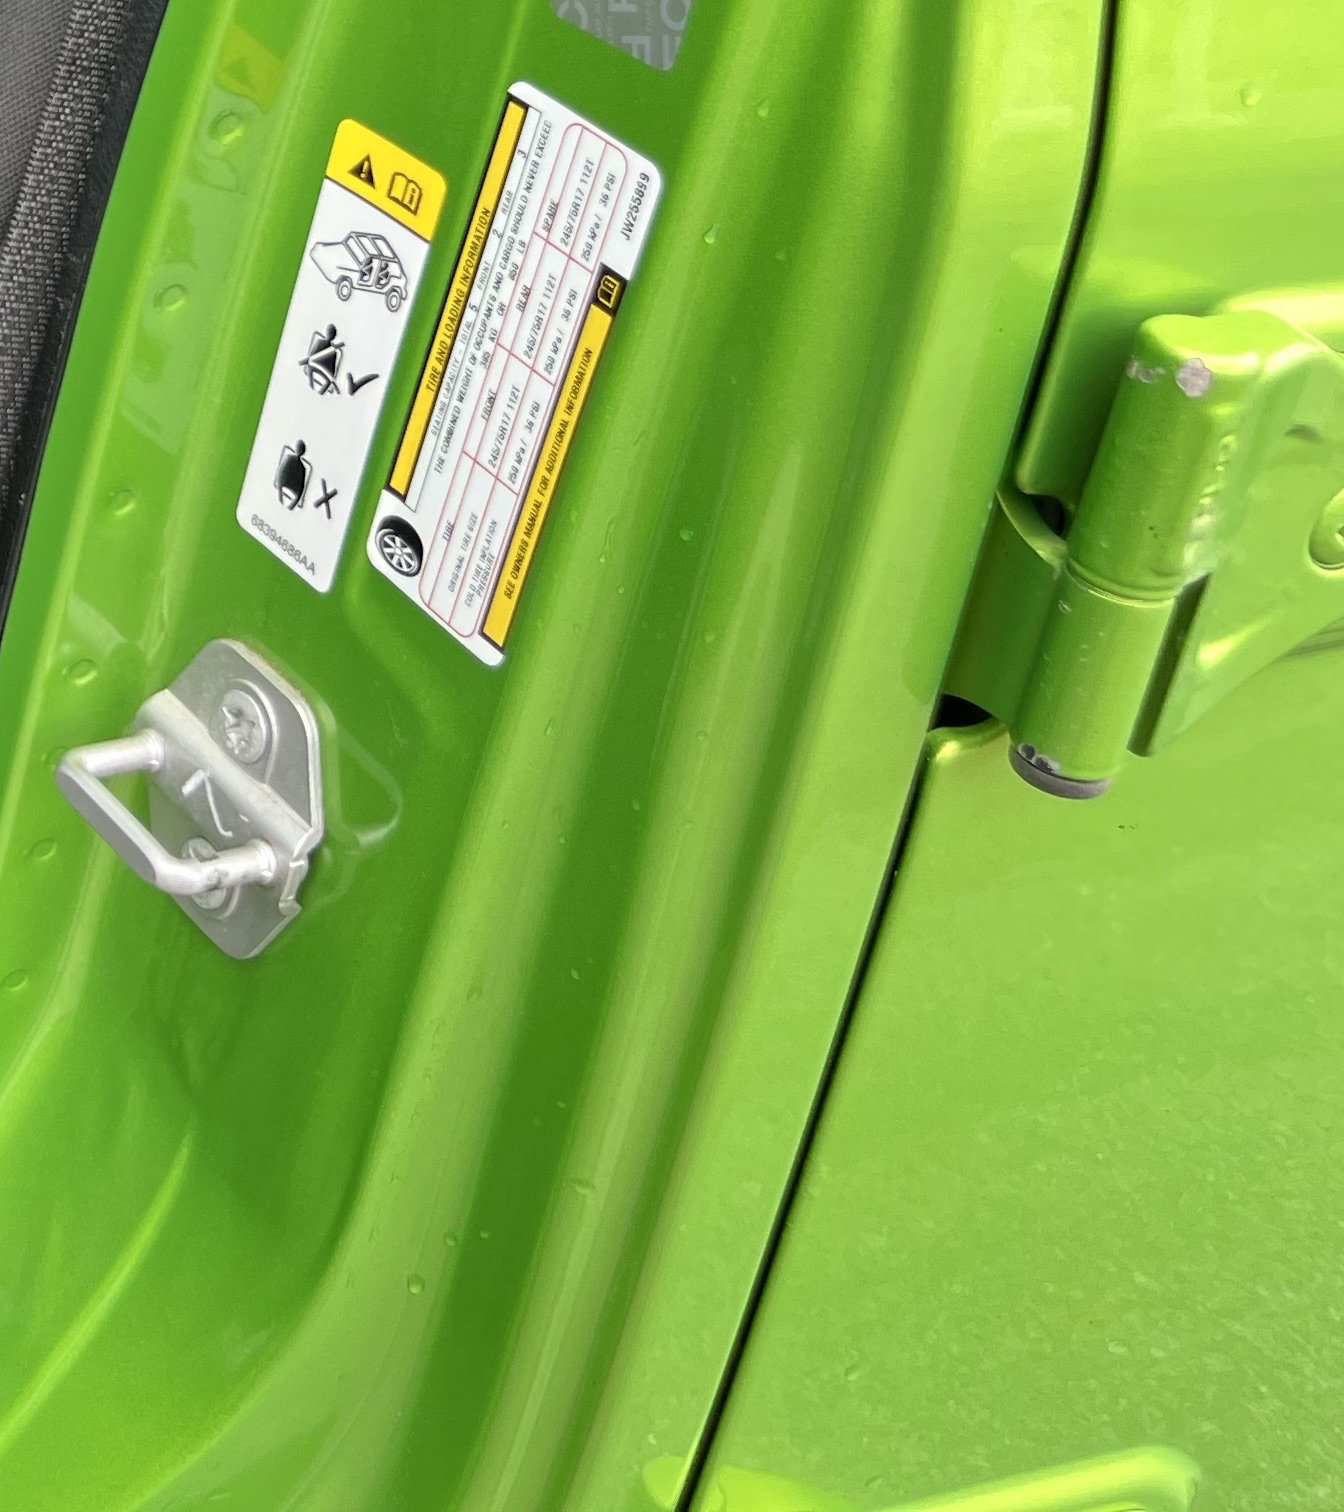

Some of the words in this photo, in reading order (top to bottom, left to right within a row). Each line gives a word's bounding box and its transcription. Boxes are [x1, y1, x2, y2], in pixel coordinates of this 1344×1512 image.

[559, 187, 584, 246] 245/75R17
[579, 158, 594, 184] 112T
[599, 192, 609, 207] 36
[603, 172, 616, 191] PSI
[620, 172, 650, 241] JW255899
[541, 200, 560, 234] SPARE
[581, 241, 593, 262] 250
[425, 365, 441, 392] TIRE
[434, 339, 449, 366] AND
[442, 287, 465, 339] LOADING
[458, 206, 491, 287] INFORMATION
[430, 400, 447, 436] SEATING
[442, 356, 459, 399] CAPACITY
[458, 320, 473, 344] TOTAL
[476, 260, 490, 290] FRONT
[500, 189, 513, 215] REAR
[433, 456, 445, 473] THE
[441, 405, 460, 454] COMBINED
[456, 367, 472, 403] WEIGHT
[468, 350, 478, 366] OF
[473, 295, 497, 351] OCCUPANTS
[491, 271, 503, 293] AND
[498, 235, 515, 270] CARGO
[510, 194, 528, 235] SHOULD
[523, 159, 539, 193] NEVER
[534, 121, 551, 159] EXCEED
[487, 327, 498, 343] KG
[496, 301, 506, 316] OR
[515, 239, 526, 254] LB
[516, 284, 531, 314] REAR
[523, 301, 547, 359] 245/75R17
[542, 272, 556, 299] 112T
[561, 308, 571, 322] 36
[565, 288, 578, 307] PSI
[543, 355, 555, 375] 250
[480, 389, 498, 423] FRONT
[487, 411, 511, 468] 245/75R17
[505, 384, 520, 410] 112T
[503, 580, 515, 599] SEE
[510, 538, 528, 579] OWNERS
[522, 499, 542, 538] MANUAL
[536, 474, 550, 496] FOR
[544, 418, 569, 475] ADDITIONAL
[563, 347, 593, 416] INFORMATION
[508, 464, 519, 484] 250
[523, 418, 534, 434] 36
[529, 400, 540, 418] PSI
[442, 521, 455, 543] TIRE
[447, 555, 465, 592] ORIGINAL
[459, 532, 471, 551] TIRE
[467, 513, 478, 532] SIZE
[463, 583, 476, 607] COLD
[471, 563, 483, 582] TIRE
[478, 519, 497, 563] INFLATION
[474, 551, 495, 597] PRESSURE
